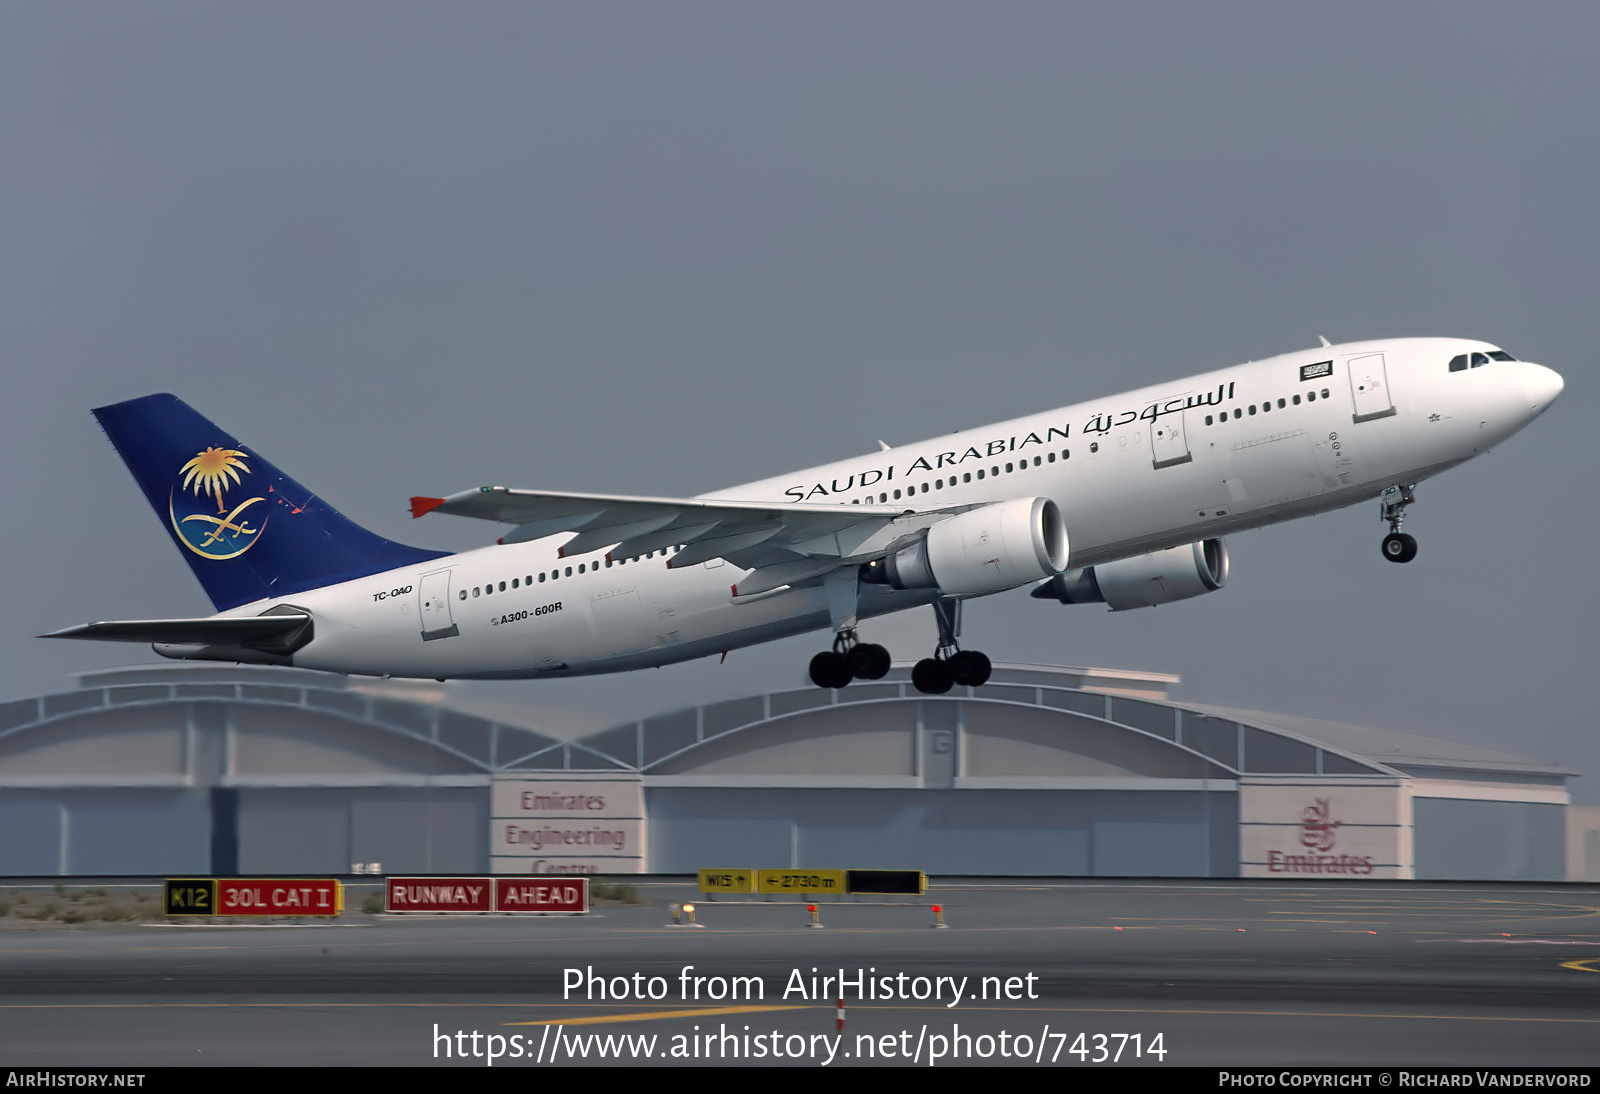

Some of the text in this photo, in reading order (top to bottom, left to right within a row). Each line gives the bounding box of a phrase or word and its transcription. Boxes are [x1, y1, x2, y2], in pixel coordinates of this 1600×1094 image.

[1083, 382, 1235, 436] السعودية
[784, 423, 1070, 503] SAUDI ARABIAN
[373, 585, 413, 602] TC-OAO
[520, 791, 605, 810] Emirates
[506, 825, 625, 850] Engineering
[1266, 850, 1374, 875] Emirates
[171, 888, 208, 907] K12
[225, 888, 267, 907] 30L
[272, 888, 312, 907] CAT
[393, 886, 579, 904] RUNWAY AHEAD
